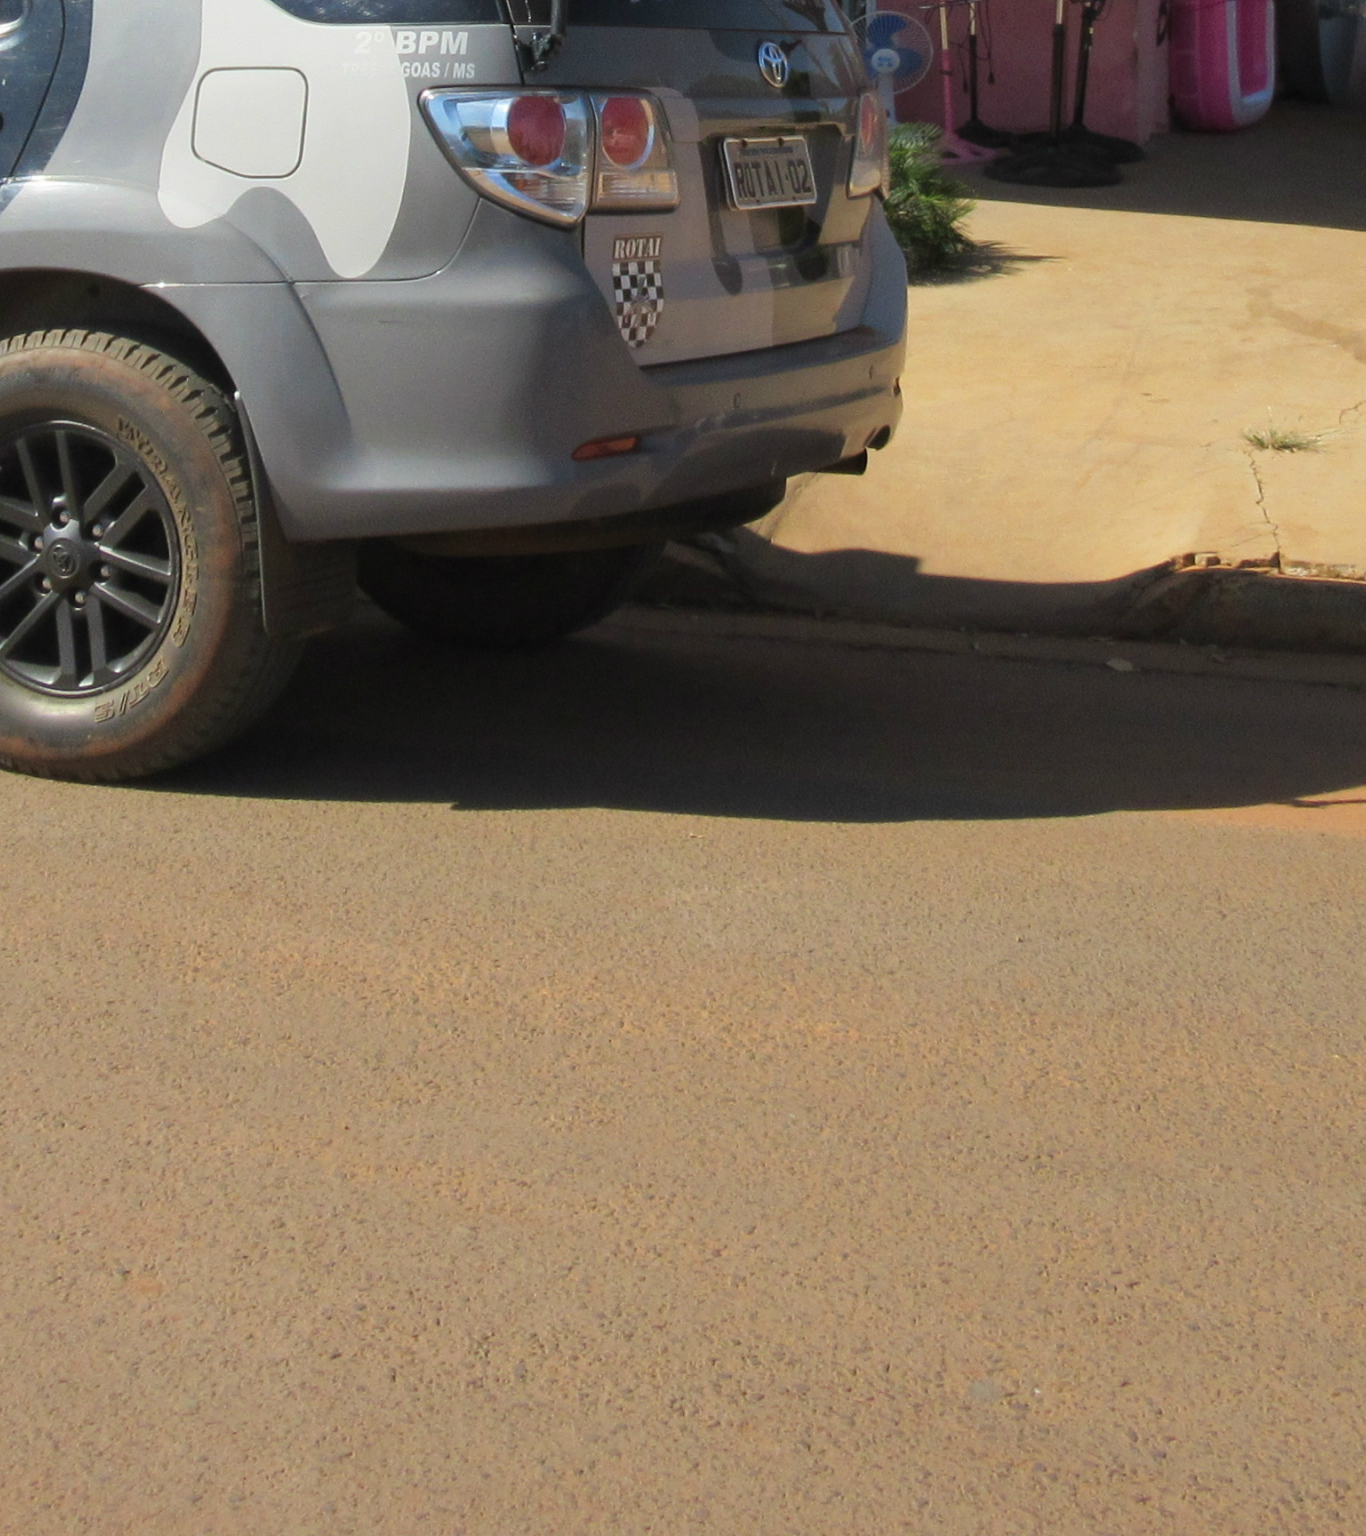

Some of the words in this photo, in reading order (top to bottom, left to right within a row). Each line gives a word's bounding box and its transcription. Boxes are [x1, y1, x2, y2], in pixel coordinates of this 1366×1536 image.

[396, 31, 469, 55] BPM
[453, 62, 476, 79] MS
[613, 237, 662, 260] ROTAI
